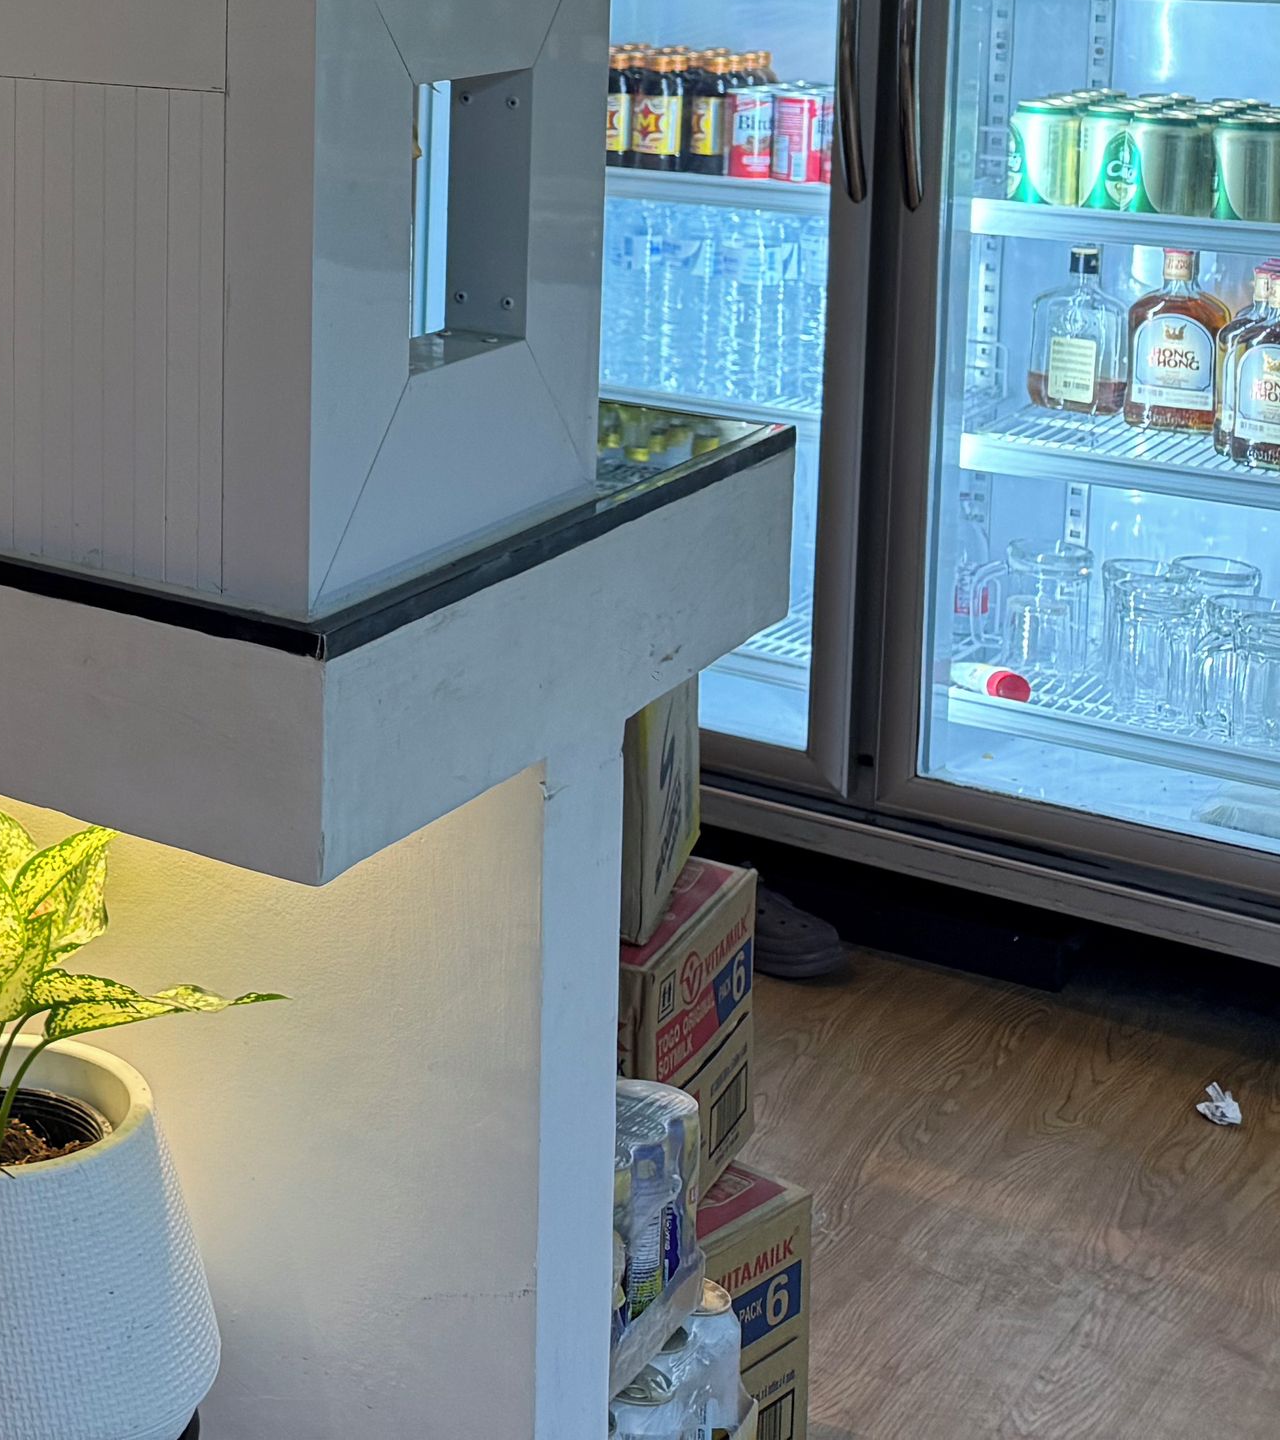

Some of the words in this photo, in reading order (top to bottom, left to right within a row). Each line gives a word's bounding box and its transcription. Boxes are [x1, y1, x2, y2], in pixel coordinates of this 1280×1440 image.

[1153, 347, 1196, 360] HONG
[705, 916, 748, 976] VITAMILK
[732, 950, 746, 1002] 6
[658, 1024, 681, 1057] TOGO
[658, 1034, 693, 1080] SOYMILK
[714, 1235, 794, 1293] VITAMILK
[739, 1296, 763, 1324] PACK
[766, 1272, 789, 1327] 6
